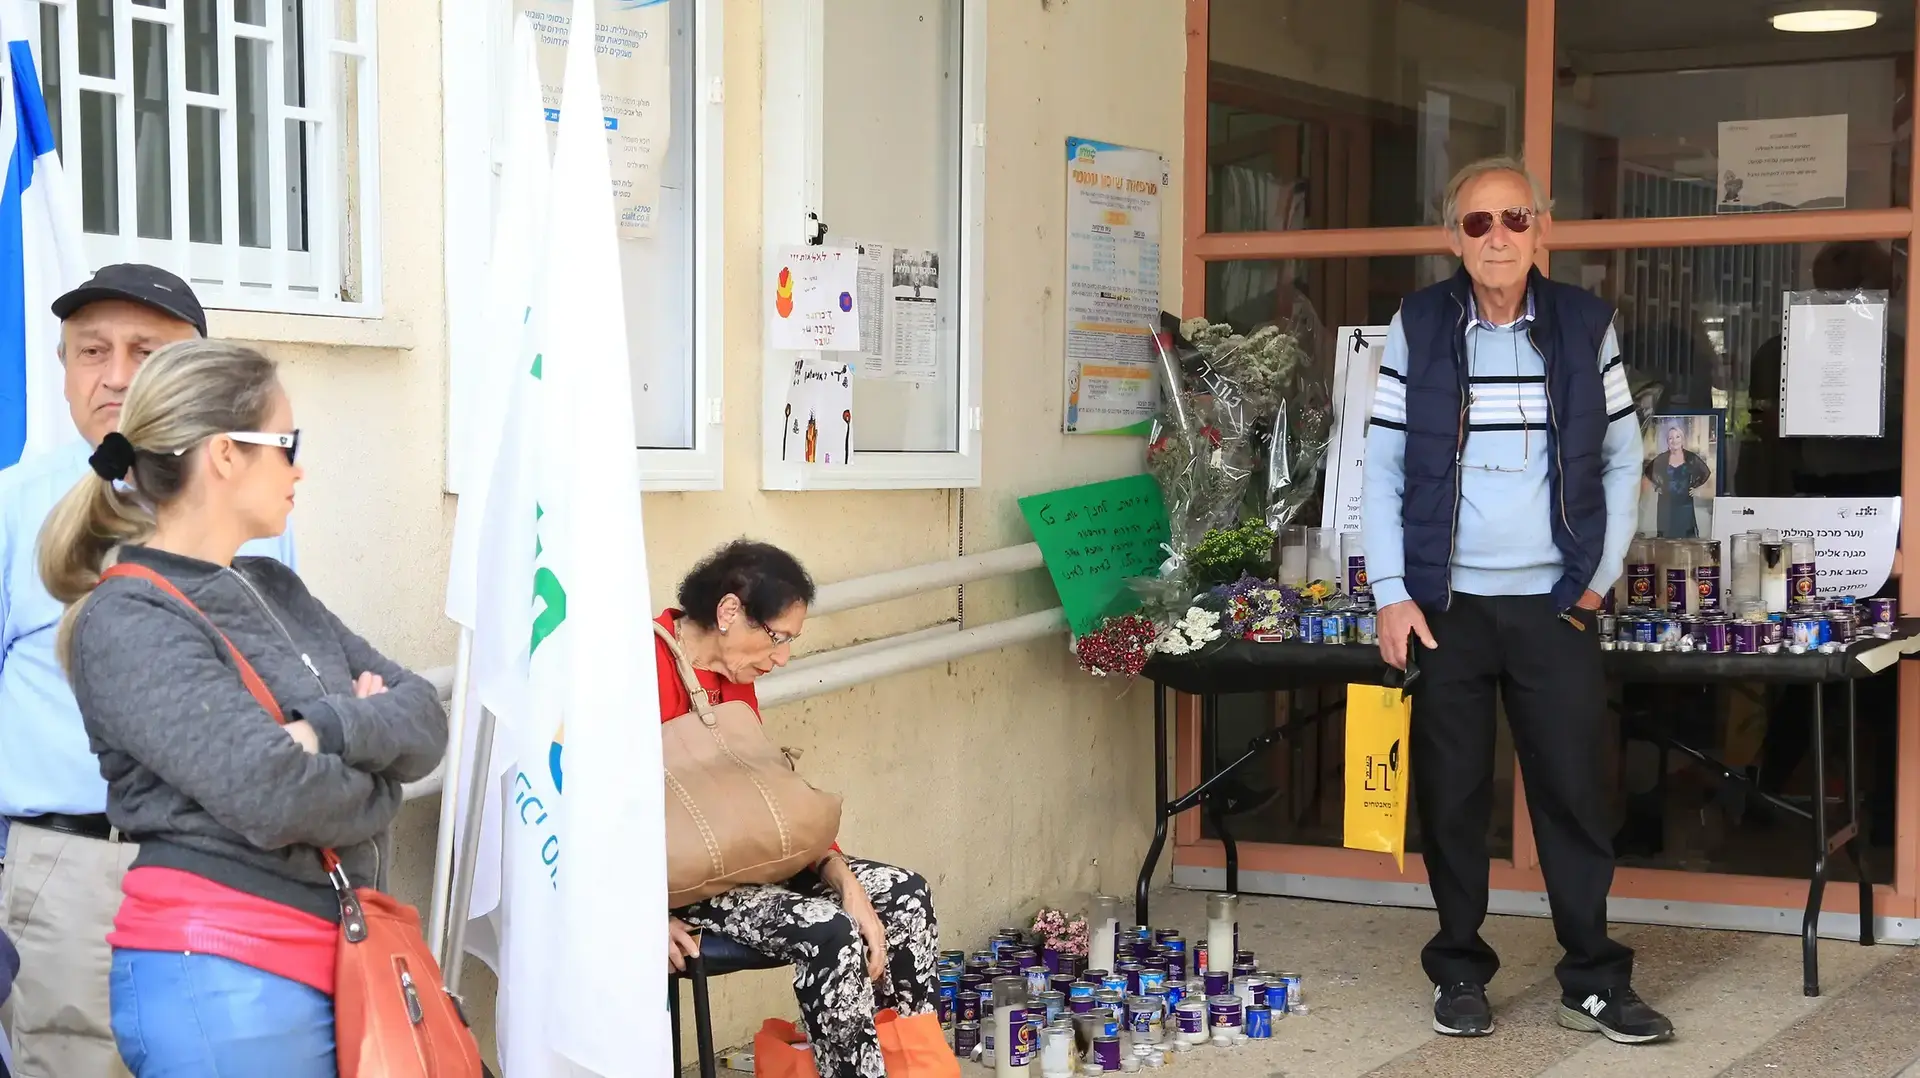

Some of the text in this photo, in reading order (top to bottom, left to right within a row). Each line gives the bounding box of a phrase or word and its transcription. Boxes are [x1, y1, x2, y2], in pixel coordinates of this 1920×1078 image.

[1780, 528, 1864, 538] נוער מרכז קהילתי
[1843, 550, 1866, 558] מגנה
